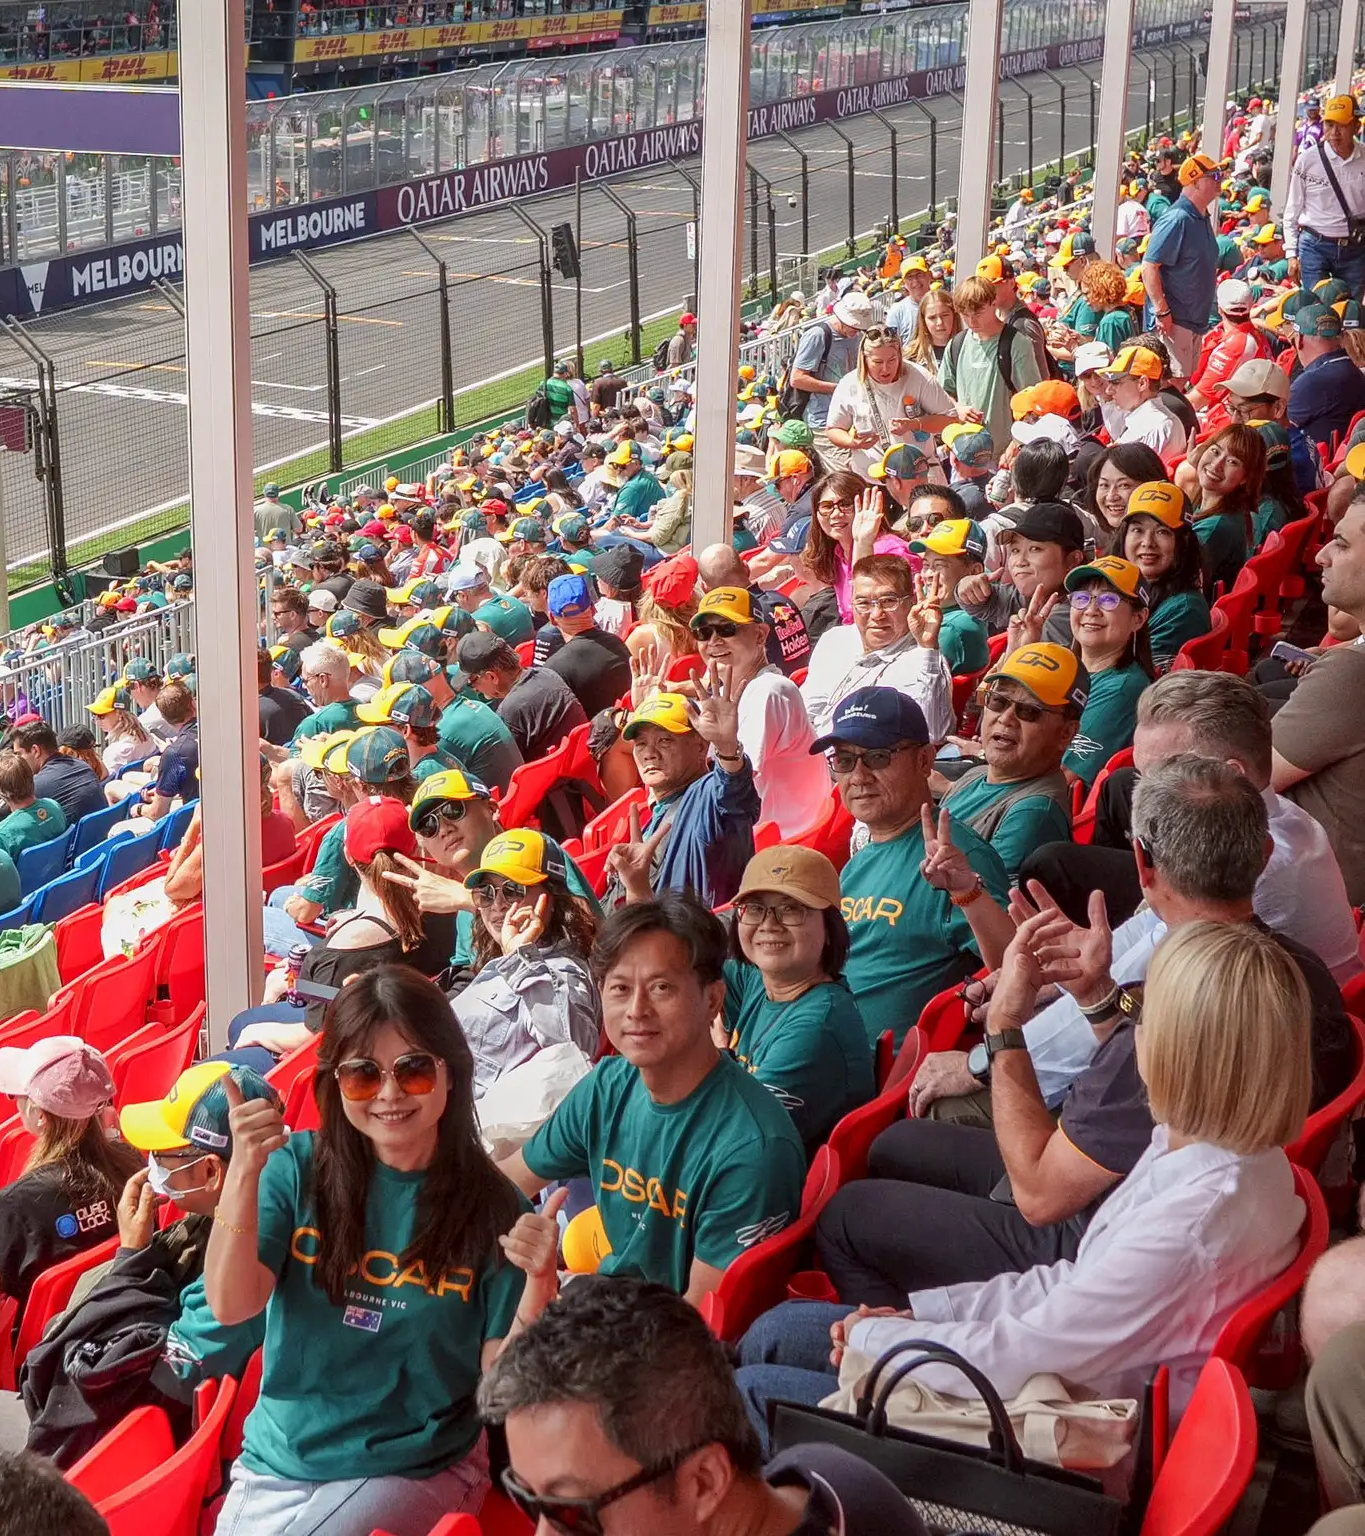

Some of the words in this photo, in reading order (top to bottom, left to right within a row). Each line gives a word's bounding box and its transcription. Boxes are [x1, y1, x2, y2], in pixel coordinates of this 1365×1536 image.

[101, 57, 148, 79] DHL
[999, 55, 1022, 80] QATAR
[1059, 43, 1078, 67] QATAR
[926, 68, 954, 94] QATAR
[837, 86, 869, 116] QATAR
[870, 76, 909, 108] AIRWAYS
[747, 107, 768, 138] TAR
[769, 97, 816, 134] AIRWAYS
[586, 136, 637, 178] QATAR
[640, 122, 700, 166] AIRWAYS
[397, 173, 466, 224] QATAR
[472, 156, 549, 210] AIRWAYS
[260, 201, 365, 251] MELBOURNE
[72, 243, 183, 297] MELBOURN
[27, 282, 45, 296] MEL
[780, 633, 809, 656] Holden
[840, 896, 903, 927] SCAR
[76, 1200, 109, 1221] QUAD
[78, 1211, 112, 1232] LOCK
[290, 1226, 475, 1304] OCAR
[343, 1290, 388, 1307] LBOURNE
[391, 1299, 407, 1310] VIC
